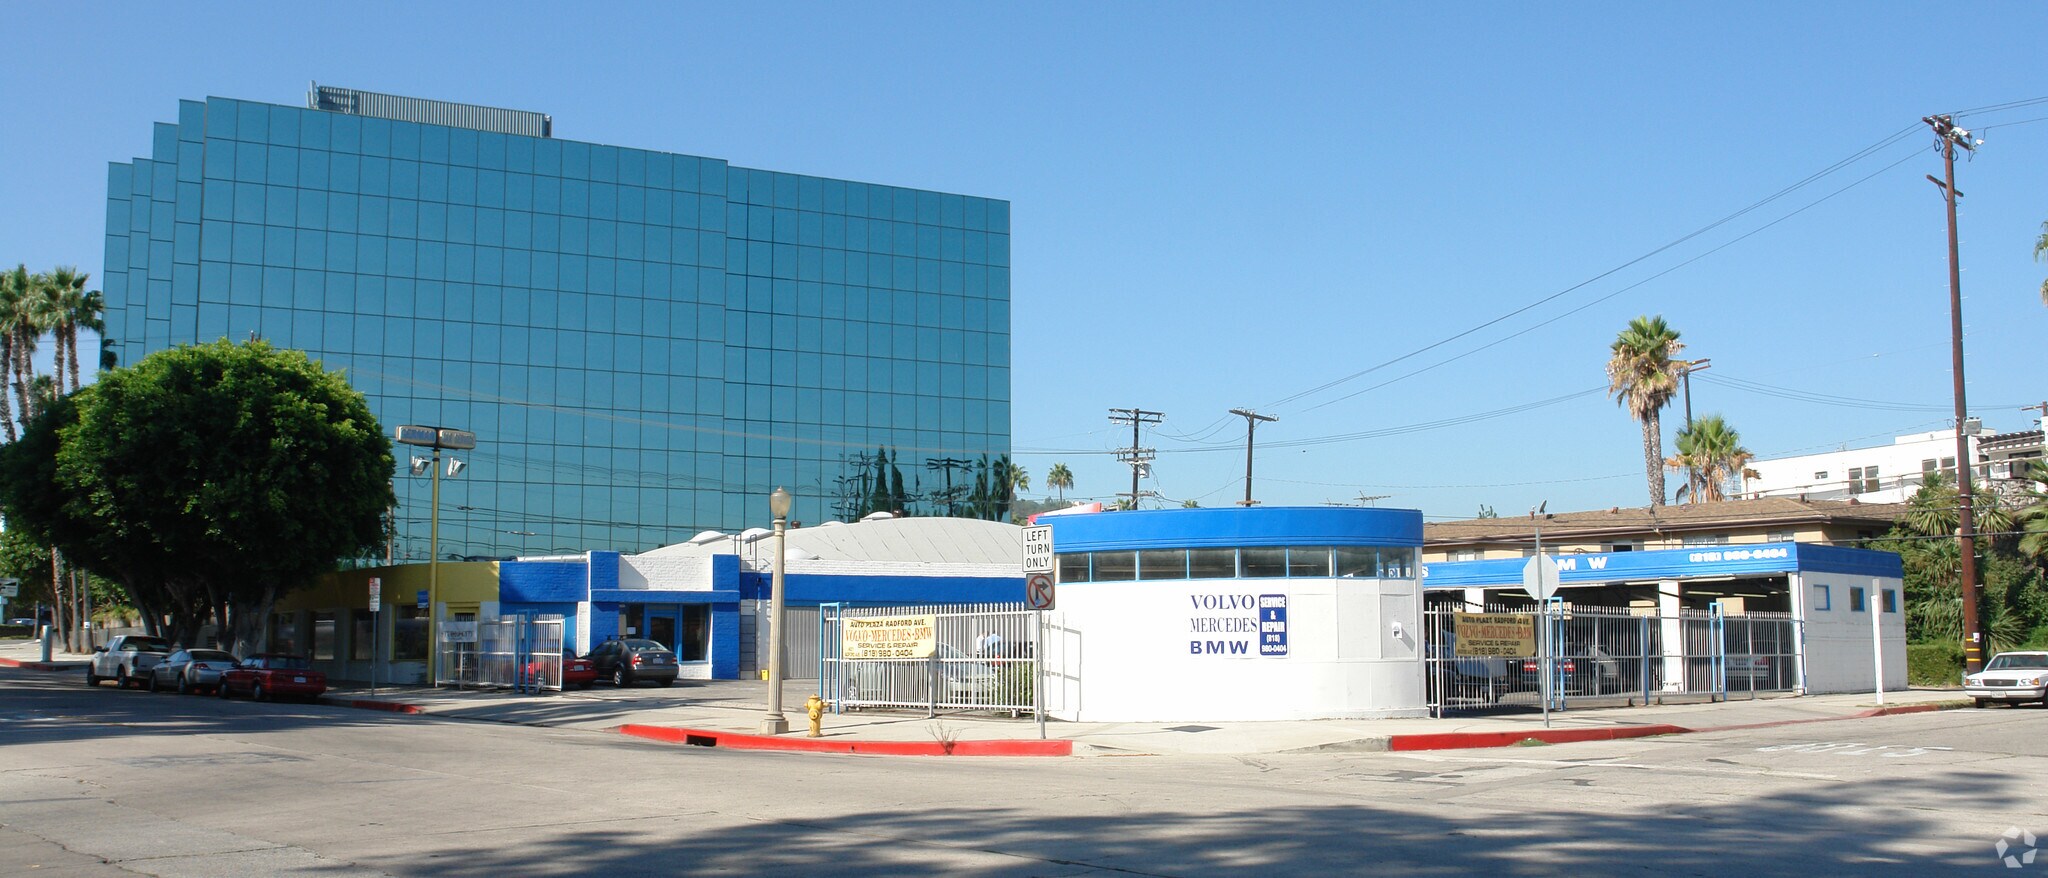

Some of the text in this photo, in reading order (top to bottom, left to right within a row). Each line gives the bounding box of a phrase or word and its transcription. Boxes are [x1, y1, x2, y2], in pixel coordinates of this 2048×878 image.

[1026, 530, 1048, 542] LEFT
[1026, 543, 1050, 555] TURN
[1026, 556, 1050, 568] ONLY
[1556, 556, 1608, 571] MW
[1190, 594, 1255, 610] VOLVO
[1260, 596, 1286, 608] SERVICE
[1270, 610, 1276, 620] &
[1494, 616, 1516, 624] RADFORD
[1190, 617, 1258, 633] MERCEDES
[1261, 621, 1286, 633] REPAIR
[1190, 640, 1249, 655] BMW
